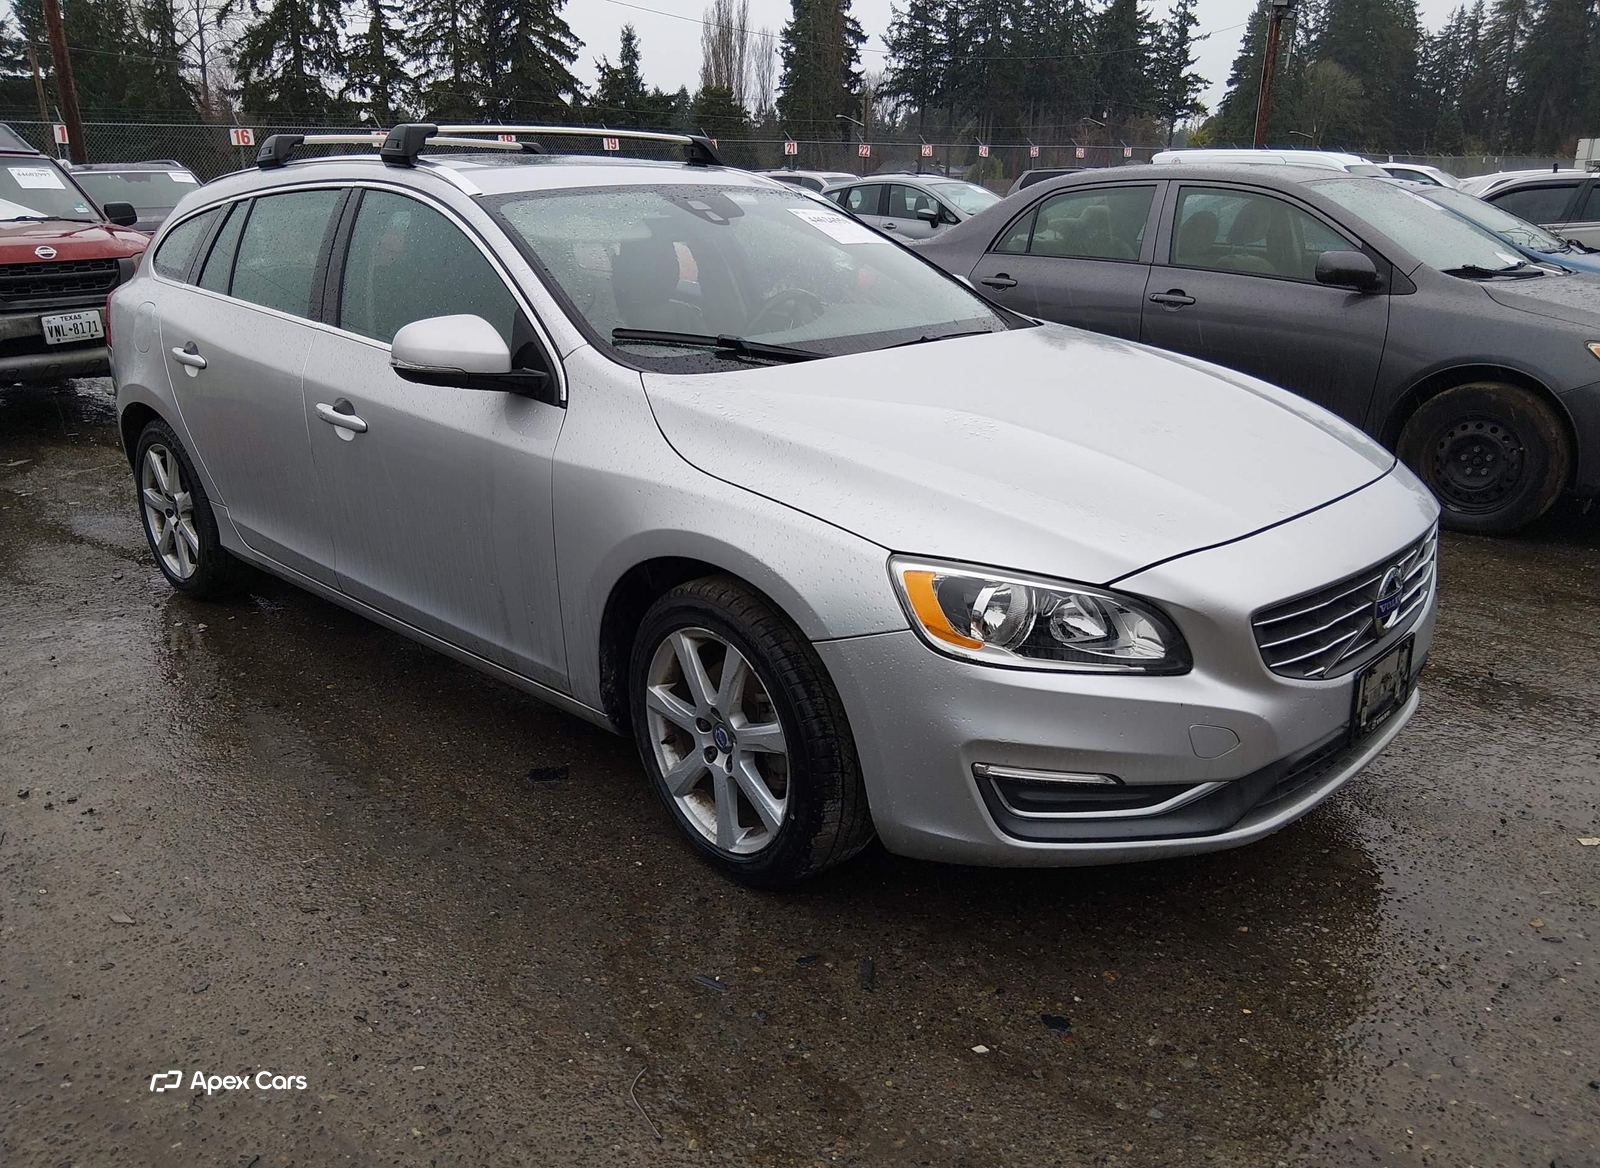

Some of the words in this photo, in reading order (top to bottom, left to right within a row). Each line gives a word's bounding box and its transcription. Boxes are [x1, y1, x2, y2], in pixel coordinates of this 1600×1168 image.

[233, 129, 251, 145] 16
[605, 138, 617, 150] 19
[786, 143, 796, 154] 21
[859, 145, 869, 156] 22
[922, 145, 932, 156] 23
[979, 146, 988, 157] 24
[59, 314, 82, 322] TEXAS
